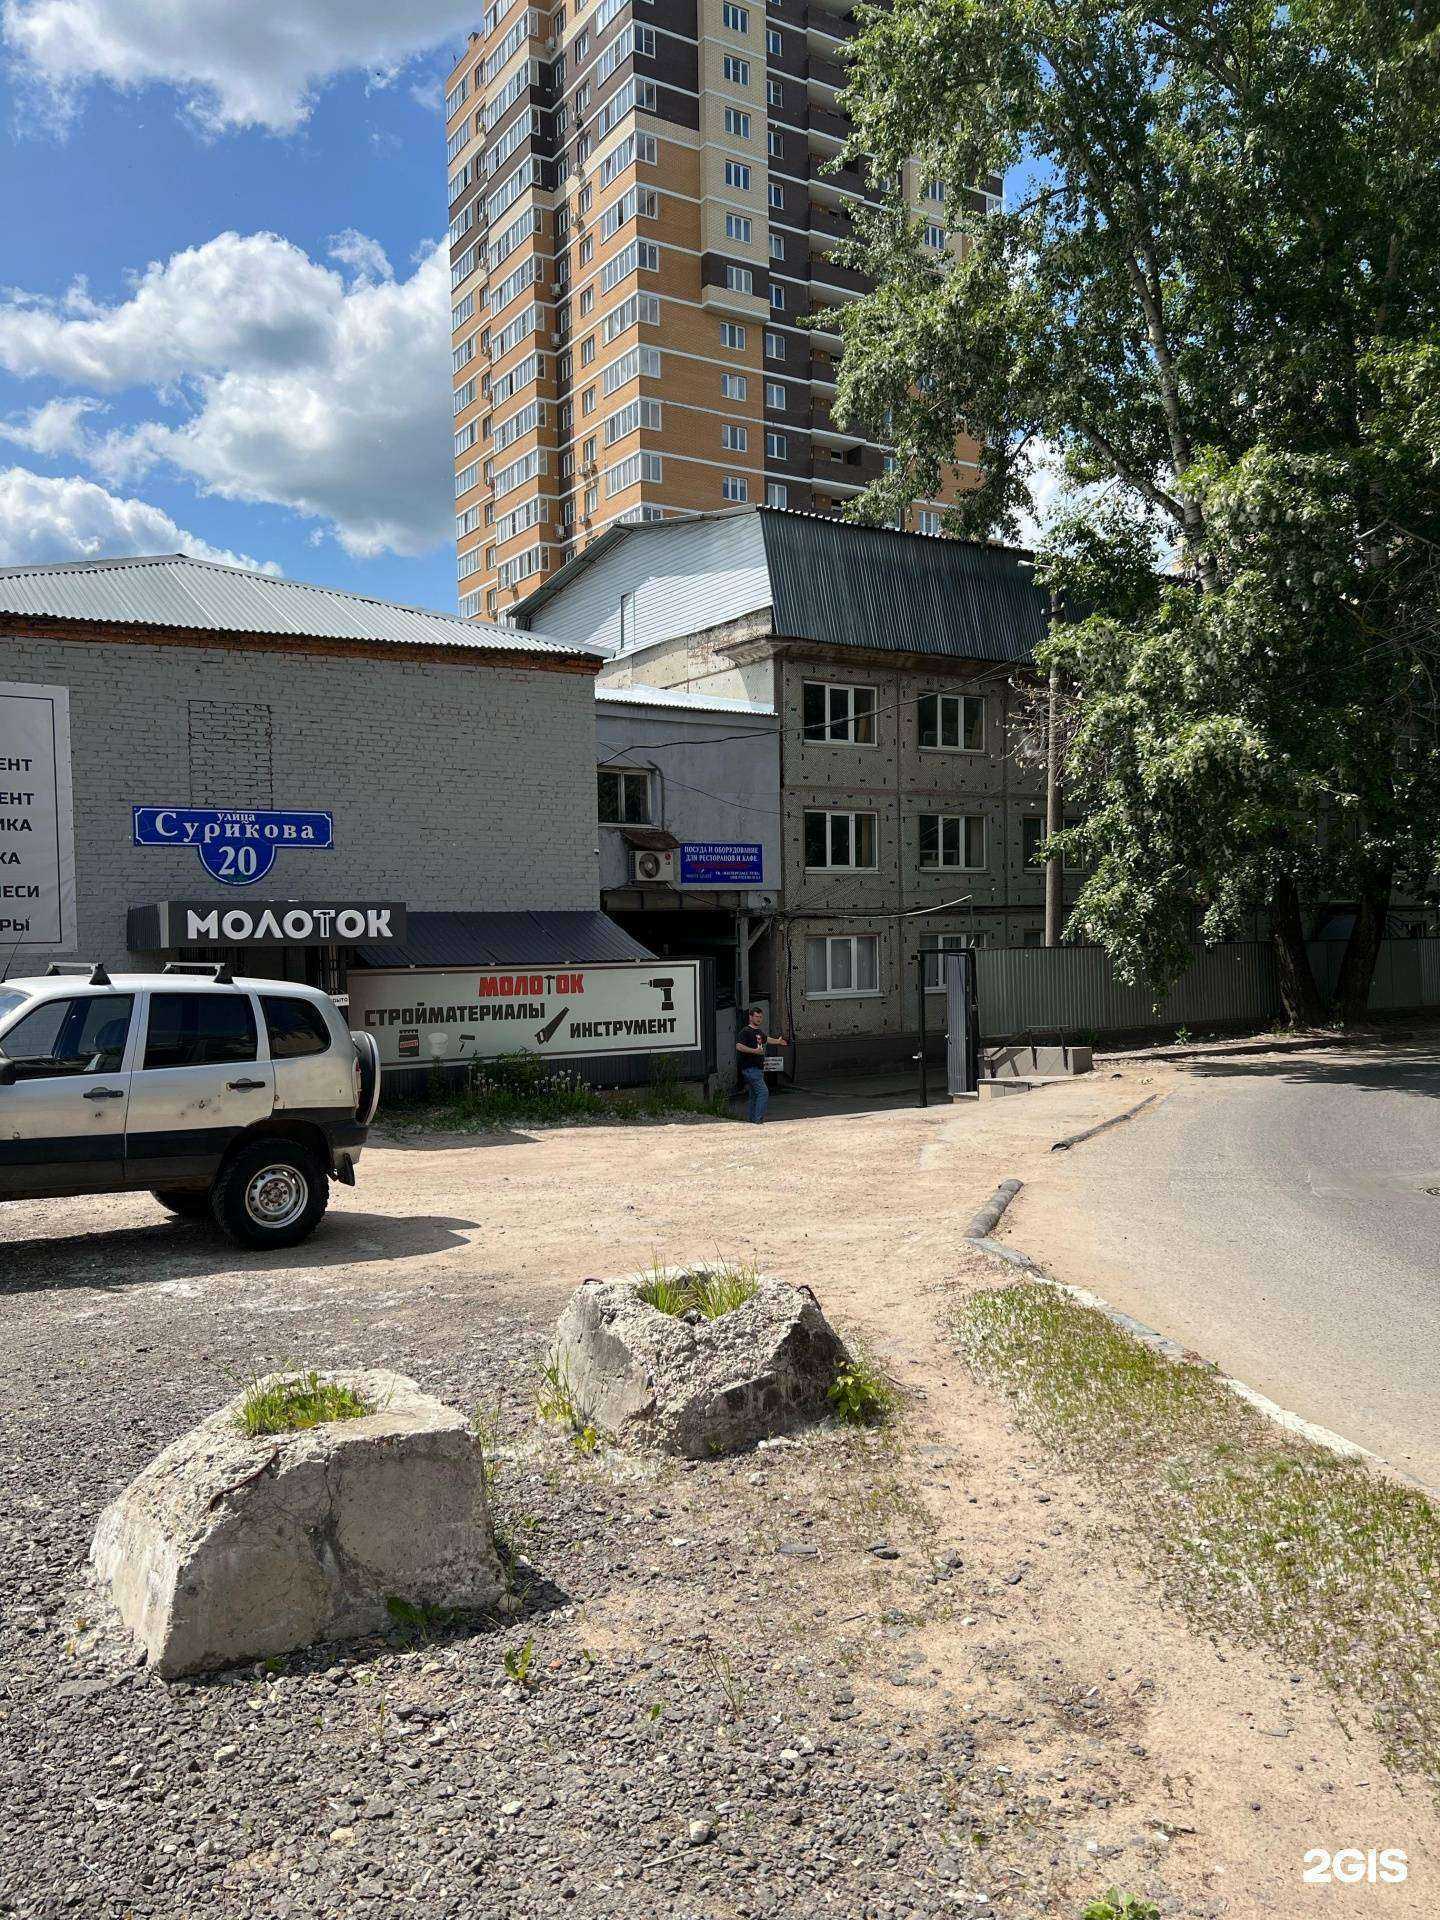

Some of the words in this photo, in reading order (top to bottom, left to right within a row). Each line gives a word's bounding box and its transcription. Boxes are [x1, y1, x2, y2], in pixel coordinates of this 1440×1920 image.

[155, 812, 315, 843] Сурикова
[216, 812, 256, 823] улица
[218, 846, 257, 876] 20
[684, 846, 708, 854] ПОСУДА
[714, 846, 759, 854] ОБОРУДОВАНИЕ
[187, 908, 394, 940] МОЛОТОК
[364, 1002, 546, 1027] СТРОЙМАТЕРИАЛЫ
[570, 1018, 677, 1038] ИНСТРУМЕНТ
